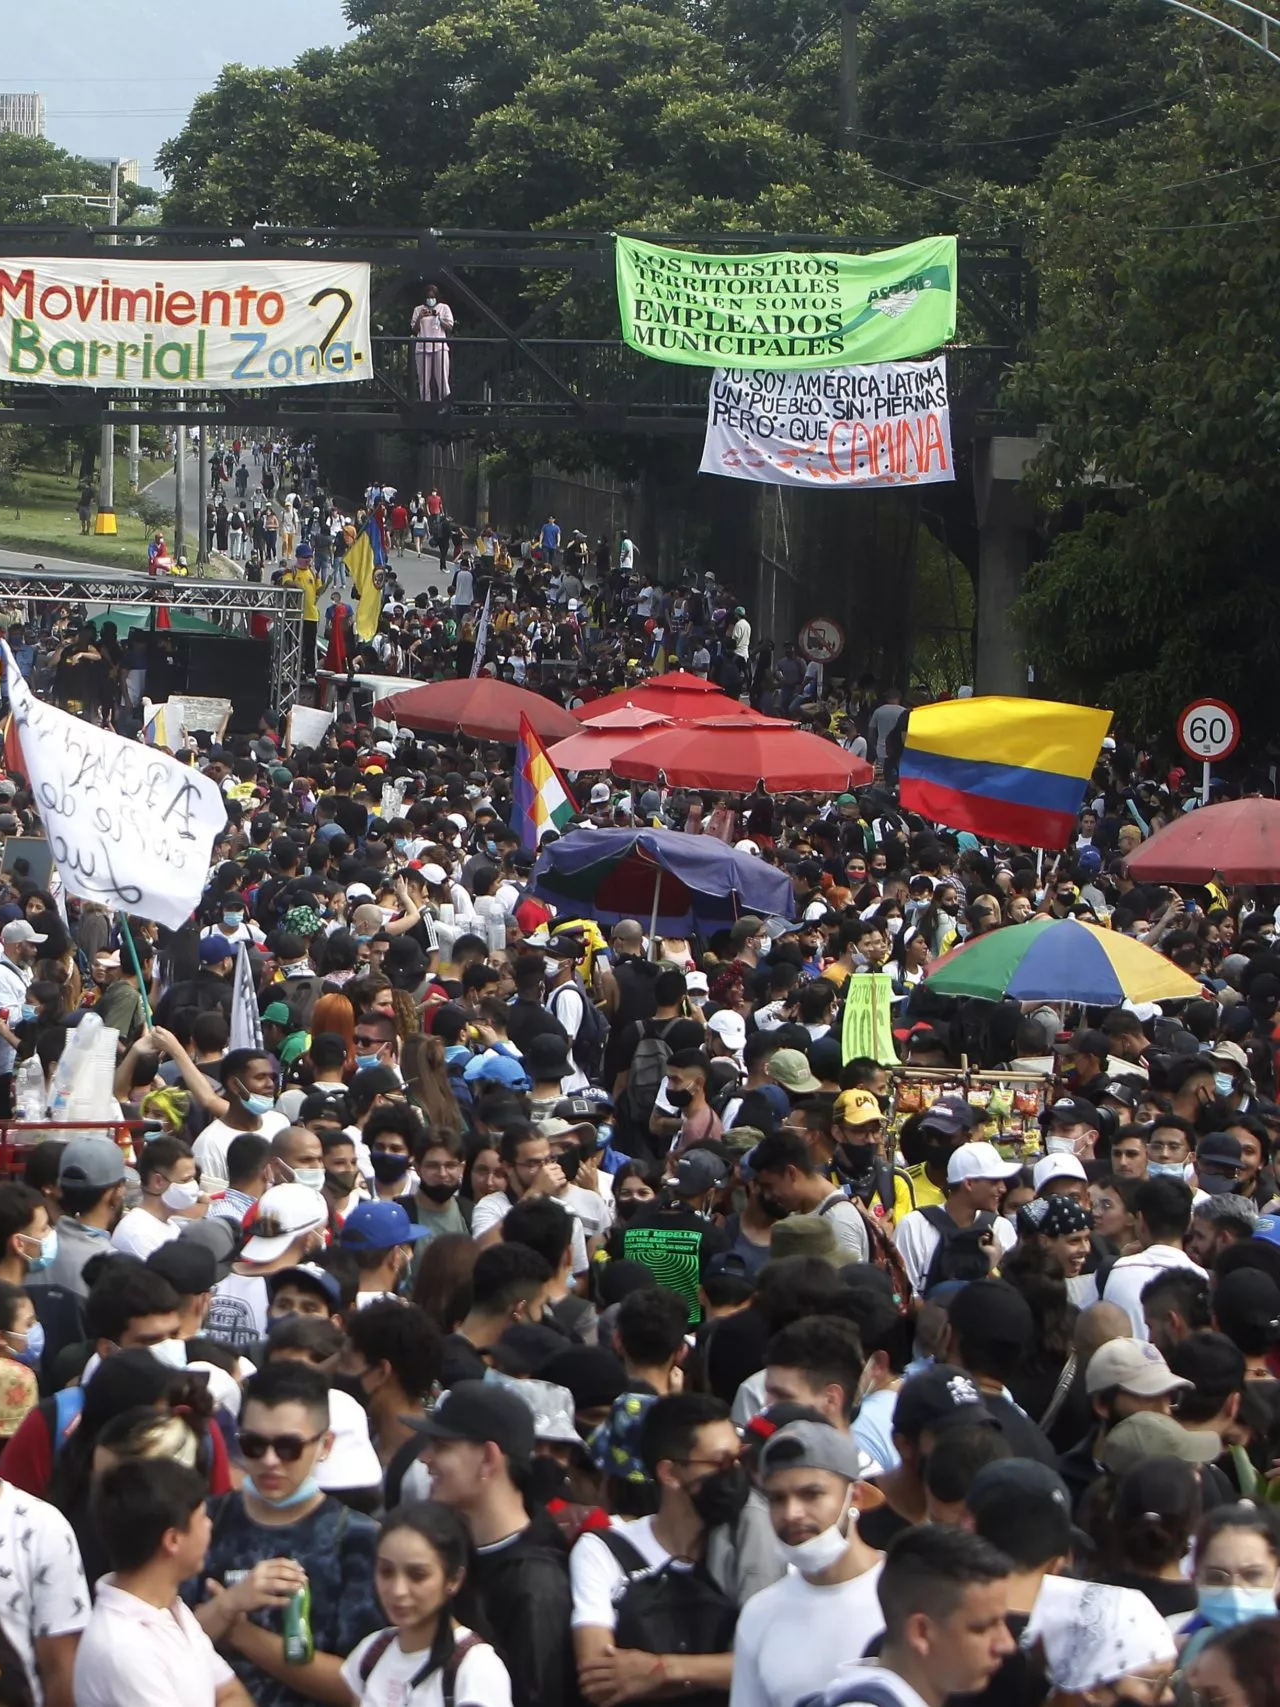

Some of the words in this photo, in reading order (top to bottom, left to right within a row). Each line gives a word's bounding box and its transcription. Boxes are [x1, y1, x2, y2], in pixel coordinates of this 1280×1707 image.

[632, 249, 681, 273] LOS
[690, 260, 839, 277] MAESTROS
[634, 264, 840, 295] TERRITORIALES
[634, 299, 843, 335] EMPLEADOS
[756, 297, 842, 310] SOMOS
[8, 318, 207, 380] Barrial
[230, 332, 353, 381] Zona
[633, 324, 844, 357] MUNICIPALES
[749, 369, 785, 396] SOY
[886, 366, 945, 395] LATINA
[714, 382, 743, 406] UN
[749, 392, 823, 415] PUEBLO
[832, 398, 865, 420] SIN
[874, 387, 947, 419] PIERNAS
[713, 401, 774, 438] PERO
[789, 418, 828, 441] QUE
[827, 412, 948, 476] CAMINA
[1190, 717, 1226, 744] 60
[855, 1096, 875, 1108] CAT
[626, 1229, 649, 1237] MUTE
[653, 1231, 700, 1239] MEDELLIN
